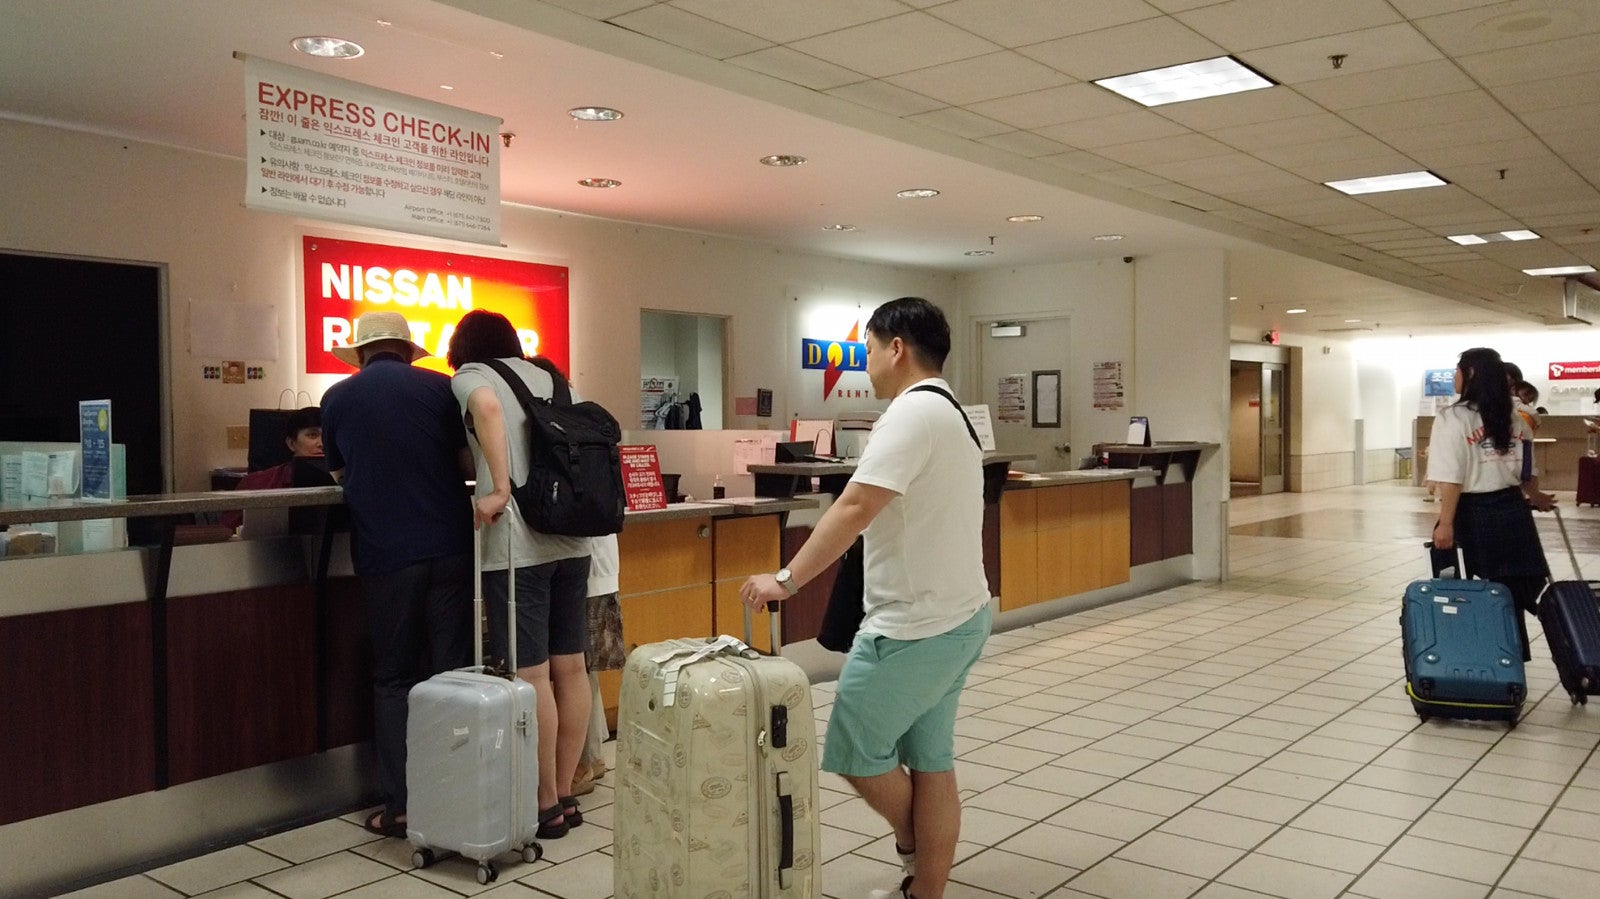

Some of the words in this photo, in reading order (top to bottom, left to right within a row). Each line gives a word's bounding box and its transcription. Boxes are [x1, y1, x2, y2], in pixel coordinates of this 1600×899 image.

[258, 81, 376, 128] EXPRESS
[383, 111, 490, 154] CHECK-IN
[258, 108, 283, 123] 잠깐!
[287, 114, 296, 126] 이
[301, 117, 319, 132] 줄은
[323, 121, 370, 142] 익스프레스
[373, 132, 399, 148] 체크인
[404, 139, 427, 154] 고객을
[431, 145, 446, 158] 위한
[450, 148, 488, 167] 라인입니다
[269, 158, 299, 171] 유의사항
[304, 164, 339, 178] 익스프레스
[340, 170, 361, 182] 체크인
[363, 174, 381, 186] 정보를
[360, 148, 393, 162] 익스프레스
[396, 156, 414, 167] 체크인
[416, 159, 435, 171] 정보를
[404, 204, 426, 212] Airport
[427, 206, 444, 216] Office
[427, 216, 444, 224] Office
[321, 262, 473, 310] NISSAN
[808, 342, 861, 368] DOL
[838, 390, 869, 398] RENT
